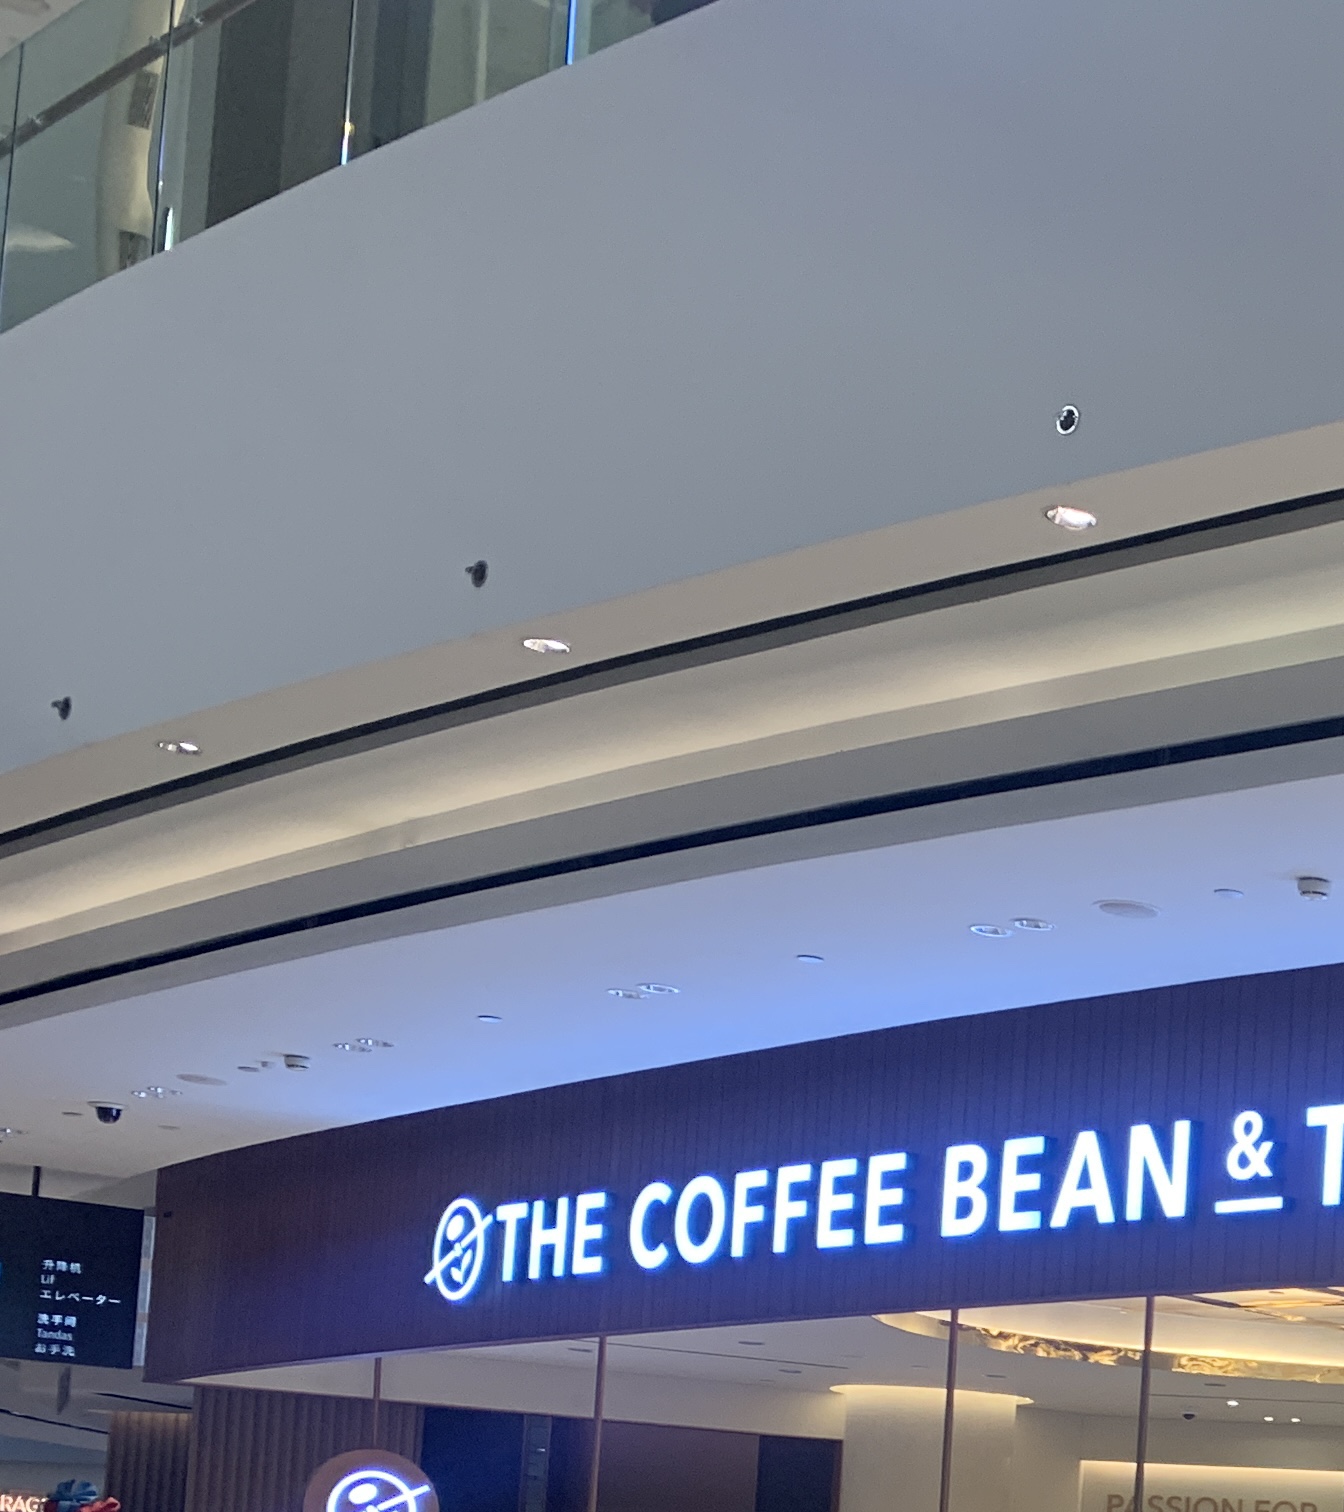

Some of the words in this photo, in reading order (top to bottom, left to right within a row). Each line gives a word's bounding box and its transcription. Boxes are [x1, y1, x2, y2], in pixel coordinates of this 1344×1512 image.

[495, 1191, 607, 1283] THE
[629, 1152, 907, 1269] COFFEE
[940, 1119, 1191, 1238] BEAN
[1226, 1110, 1274, 1181] &
[39, 1288, 121, 1305] エレベーター
[37, 1328, 73, 1342] Tandas
